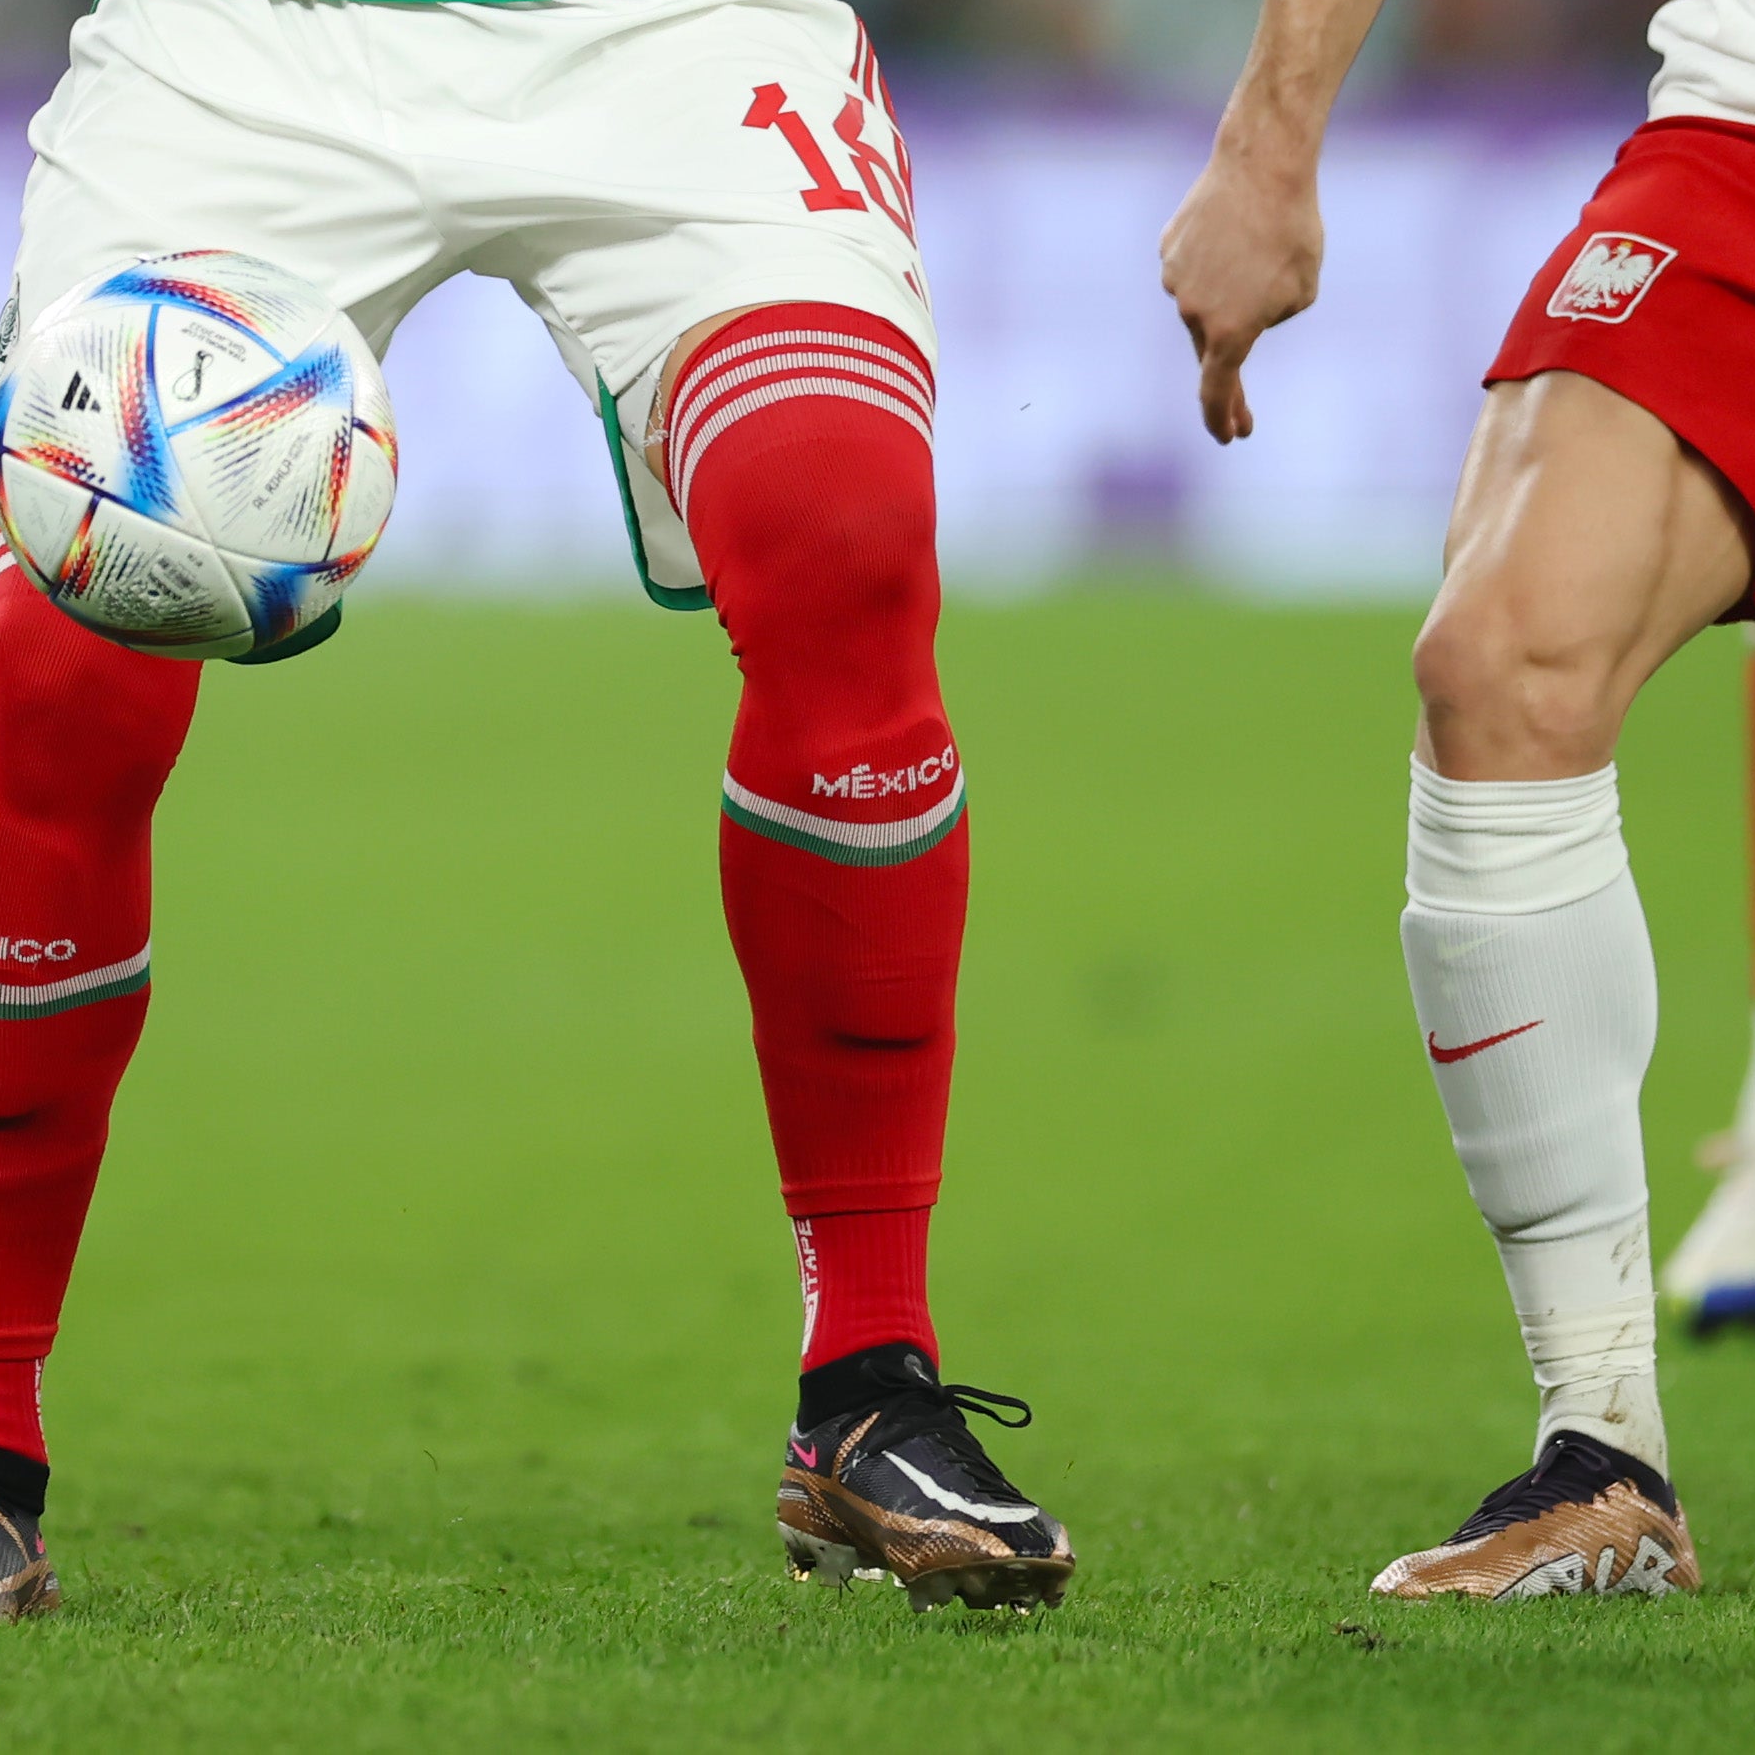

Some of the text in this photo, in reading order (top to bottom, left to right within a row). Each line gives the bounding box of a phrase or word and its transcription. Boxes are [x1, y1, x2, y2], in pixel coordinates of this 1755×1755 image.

[741, 82, 918, 250] 16
[810, 743, 955, 800] MÉXICO
[796, 1218, 818, 1291] TAPE
